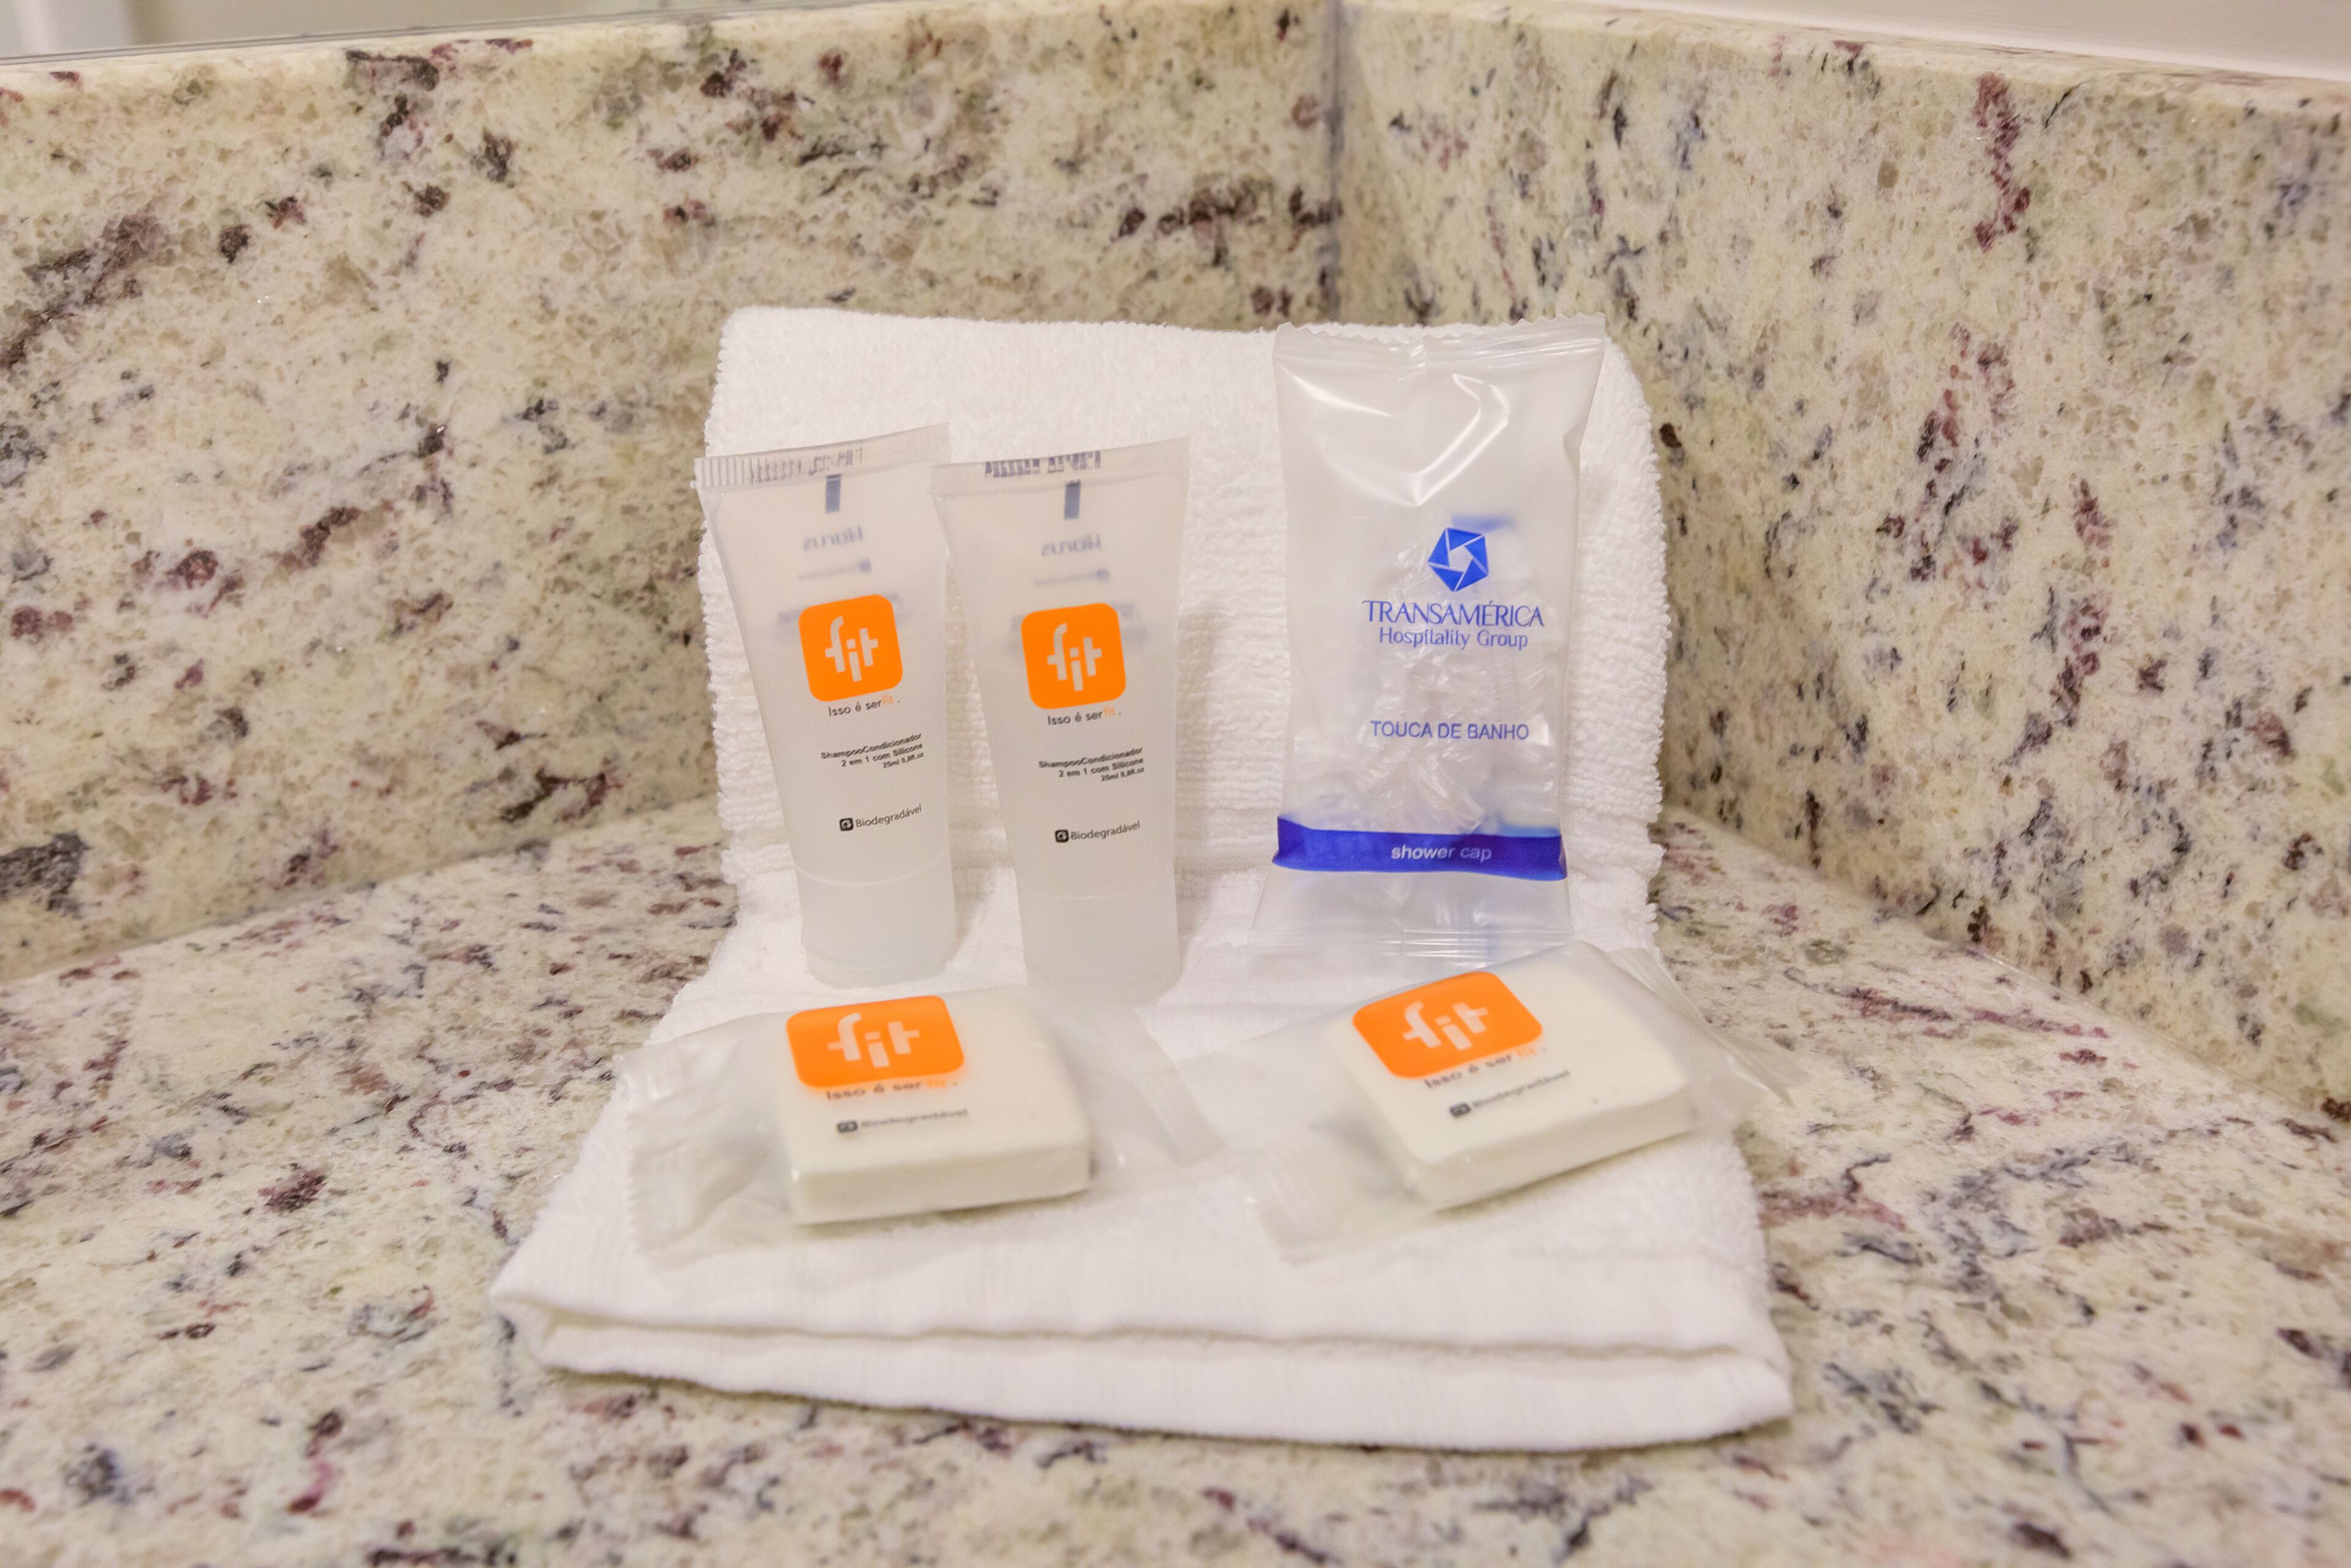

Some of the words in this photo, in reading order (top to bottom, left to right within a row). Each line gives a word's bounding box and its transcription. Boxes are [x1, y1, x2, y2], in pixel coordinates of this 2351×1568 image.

[1362, 599, 1545, 628] TRANSAMÉRICA
[825, 615, 879, 683] fit
[1379, 626, 1471, 650] Hospitality
[1476, 629, 1528, 651] Group
[1046, 623, 1102, 692] fit
[828, 705, 851, 717] Isso
[855, 701, 862, 712] é
[1047, 715, 1071, 726] Isso
[1074, 711, 1082, 722] é
[1370, 720, 1433, 738] TOUCA
[1438, 722, 1462, 739] DE
[1467, 723, 1529, 740] BANHO
[820, 733, 922, 759] ShampooCondicionador
[872, 752, 891, 761] com
[893, 743, 923, 757] Silicone
[1112, 757, 1144, 770] Silicone
[855, 803, 922, 828] Biodegradável
[1070, 819, 1141, 841] Biodegradável
[1390, 844, 1456, 860] shower
[1459, 846, 1493, 863] cap
[1401, 1000, 1489, 1051] fit
[827, 1011, 921, 1069] fit
